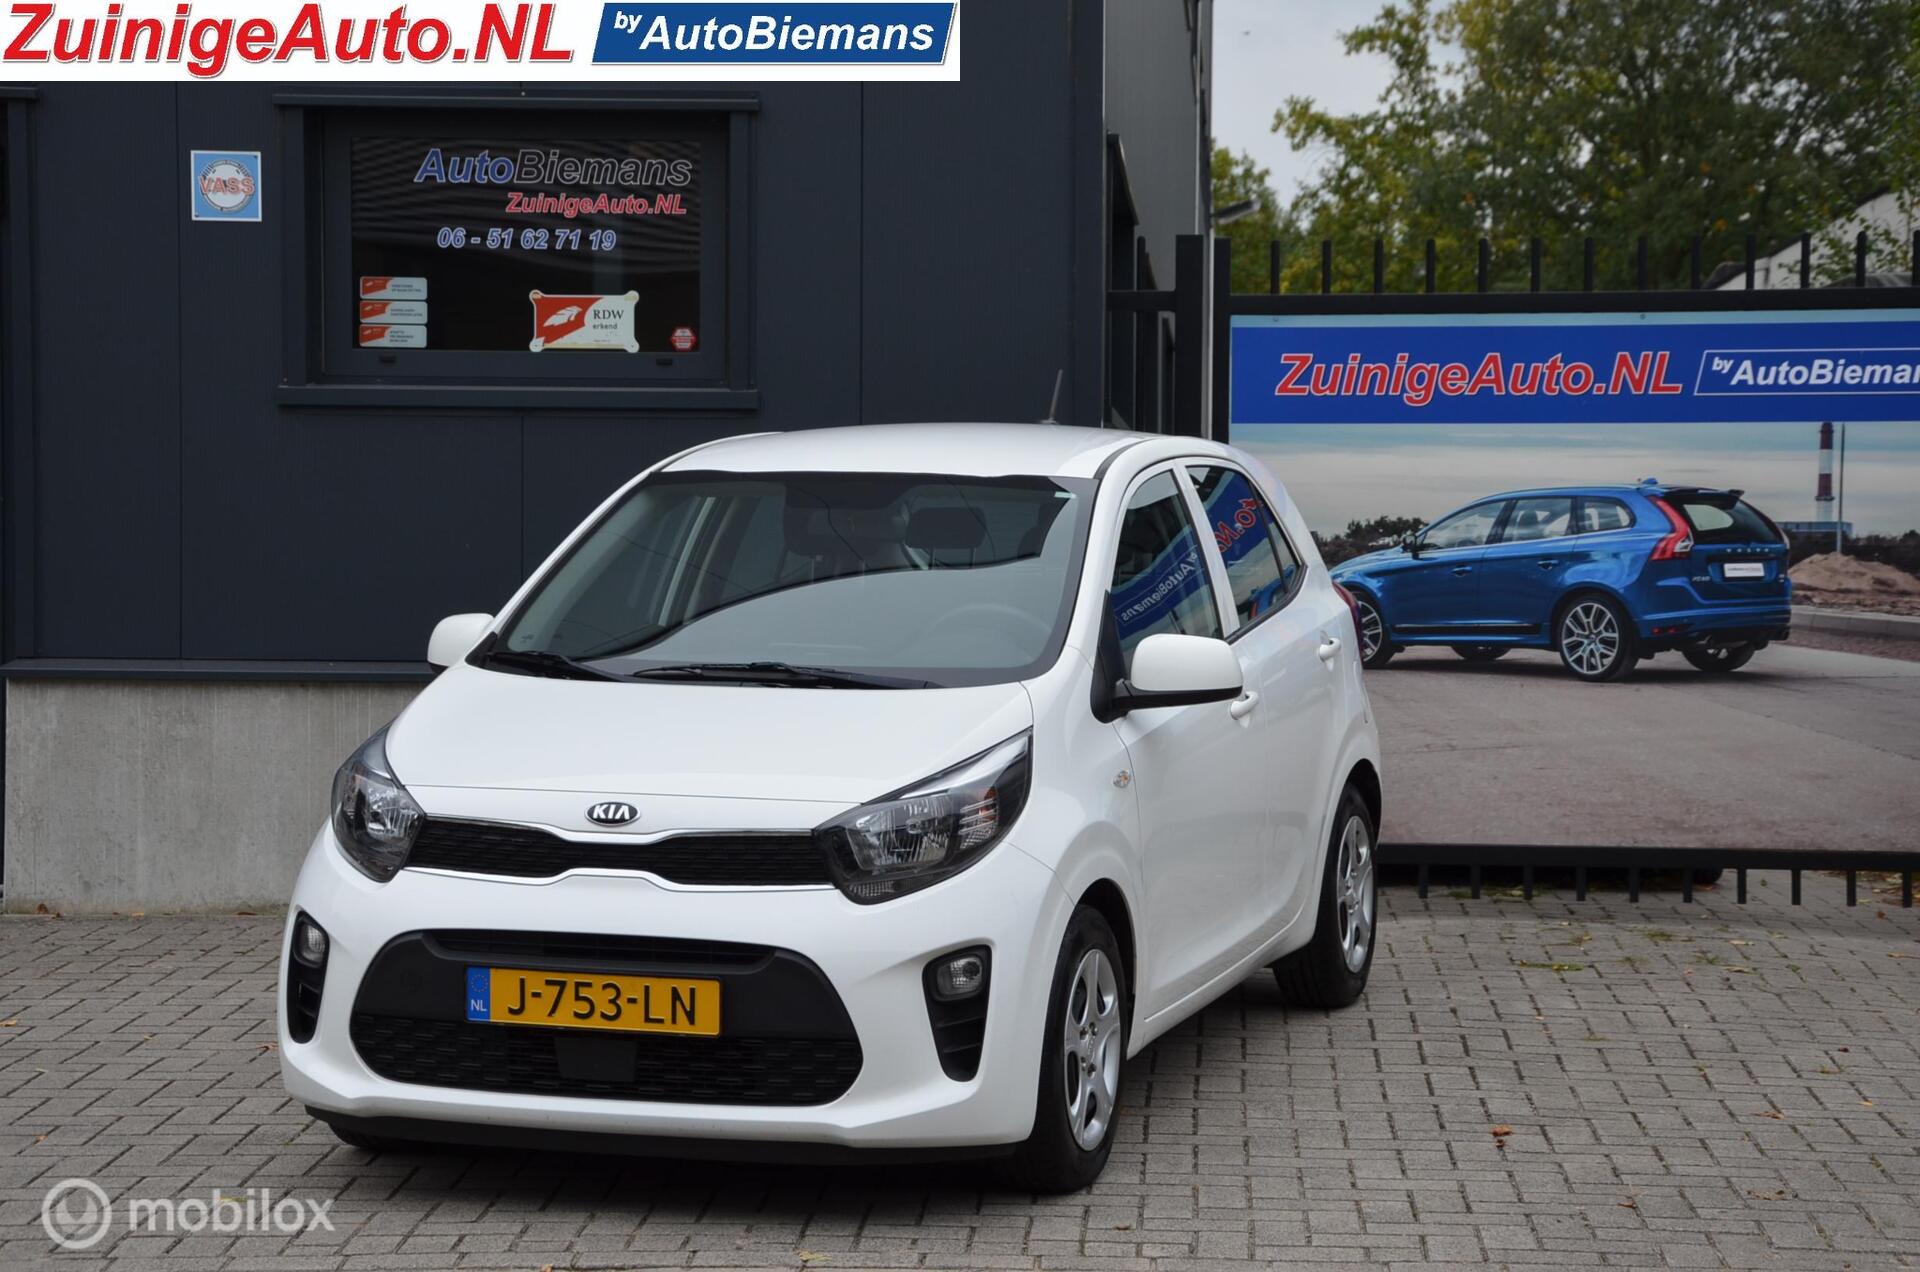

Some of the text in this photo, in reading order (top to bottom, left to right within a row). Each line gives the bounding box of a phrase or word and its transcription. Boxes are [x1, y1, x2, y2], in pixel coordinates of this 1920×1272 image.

[414, 148, 693, 186] AutoBiemans
[198, 175, 255, 195] VASS
[506, 192, 687, 218] ZuinigeAuto.NL
[437, 227, 466, 248] 06
[486, 228, 515, 249] 51
[520, 228, 549, 249] 62
[555, 229, 582, 249] 71
[589, 230, 616, 250] 19
[593, 309, 624, 320] RDW
[1712, 356, 1734, 374] by
[1275, 352, 1683, 406] ZuinigeAuto.NL
[592, 804, 630, 819] KIA
[471, 999, 487, 1011] NL
[508, 976, 697, 1026] J-753-LN
